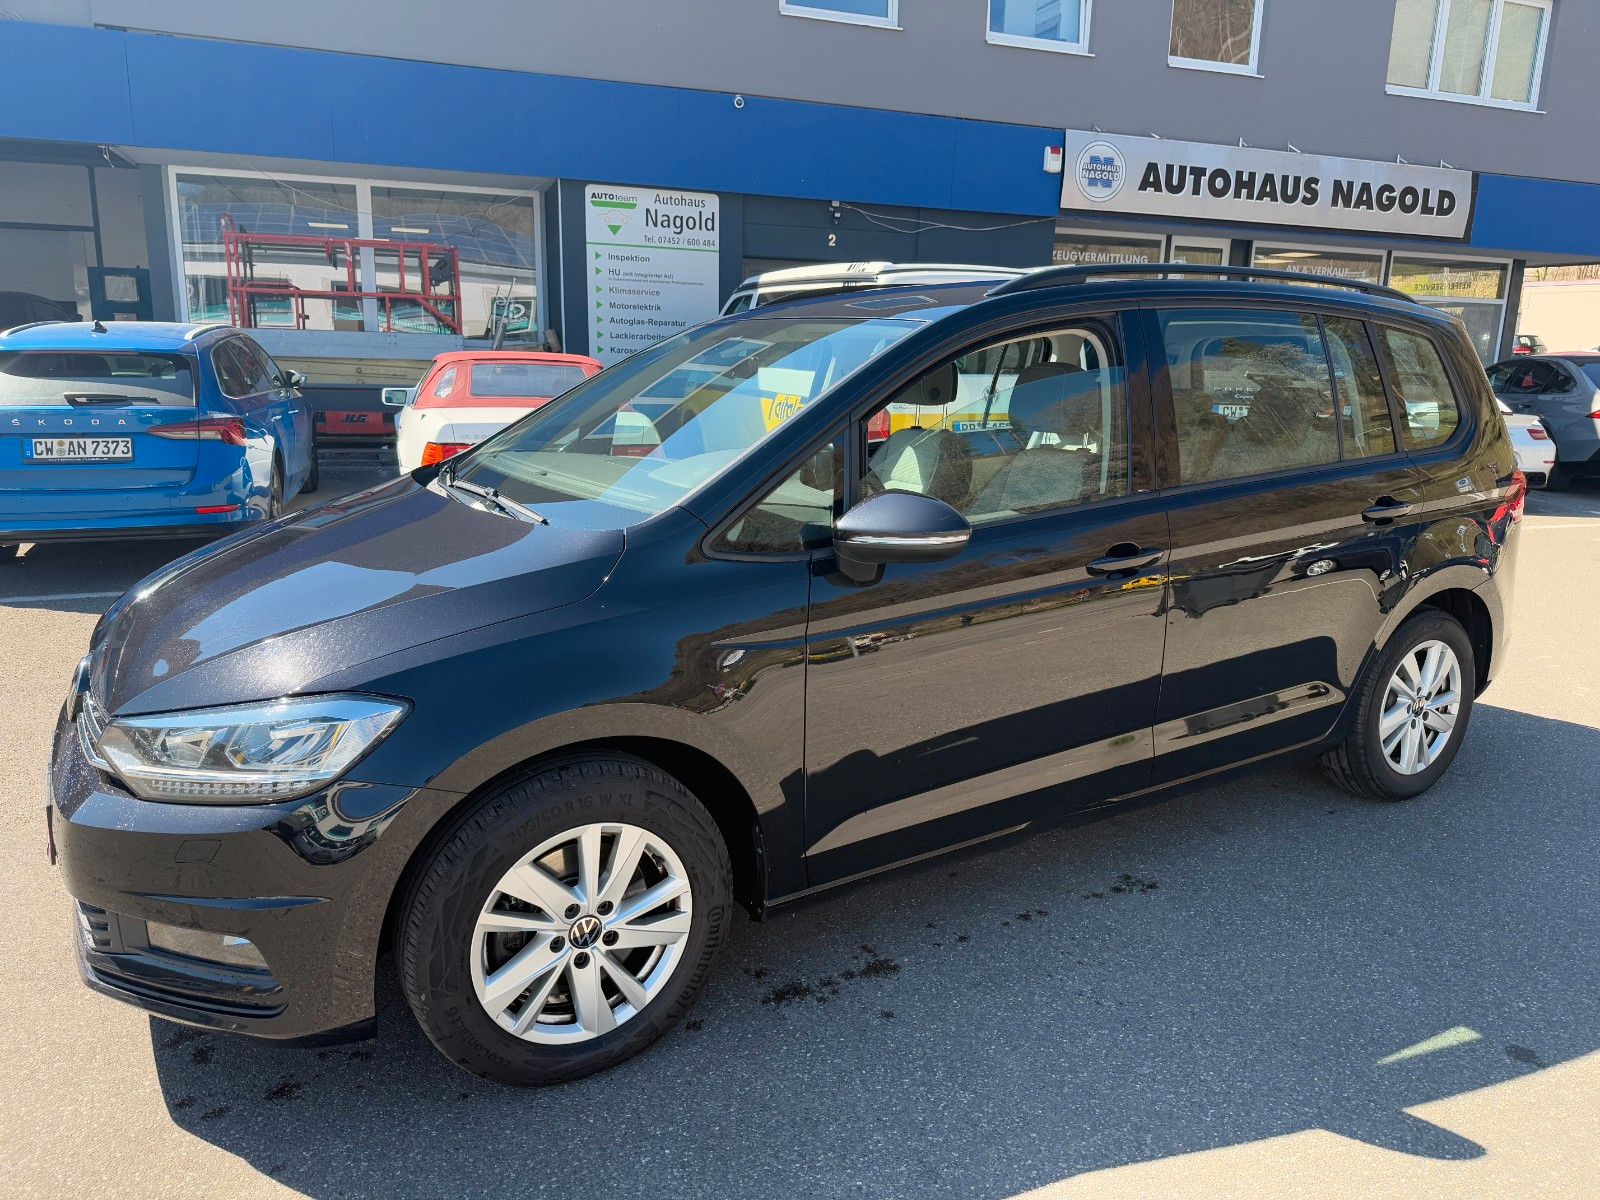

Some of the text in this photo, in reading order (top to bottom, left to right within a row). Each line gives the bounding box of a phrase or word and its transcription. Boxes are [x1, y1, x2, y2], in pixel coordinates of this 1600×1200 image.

[1083, 162, 1121, 172] AUTOHAUS
[1081, 171, 1121, 182] NAGOLD
[1138, 162, 1457, 217] AUTOHAUS NAGOLD
[653, 194, 706, 208] Autohaus
[645, 208, 715, 235] Nagold
[644, 235, 656, 243] Tel.
[657, 236, 681, 245] 07452
[687, 238, 701, 247] 600
[702, 239, 716, 247] 484
[828, 233, 836, 247] 2
[608, 253, 650, 263] Inspektion
[608, 268, 621, 276] HU
[608, 286, 661, 297] Klimaservice
[609, 301, 662, 312] Motorelektrik
[609, 316, 687, 327] Autoglas-Reparatur
[33, 440, 131, 456] CW AN 7373
